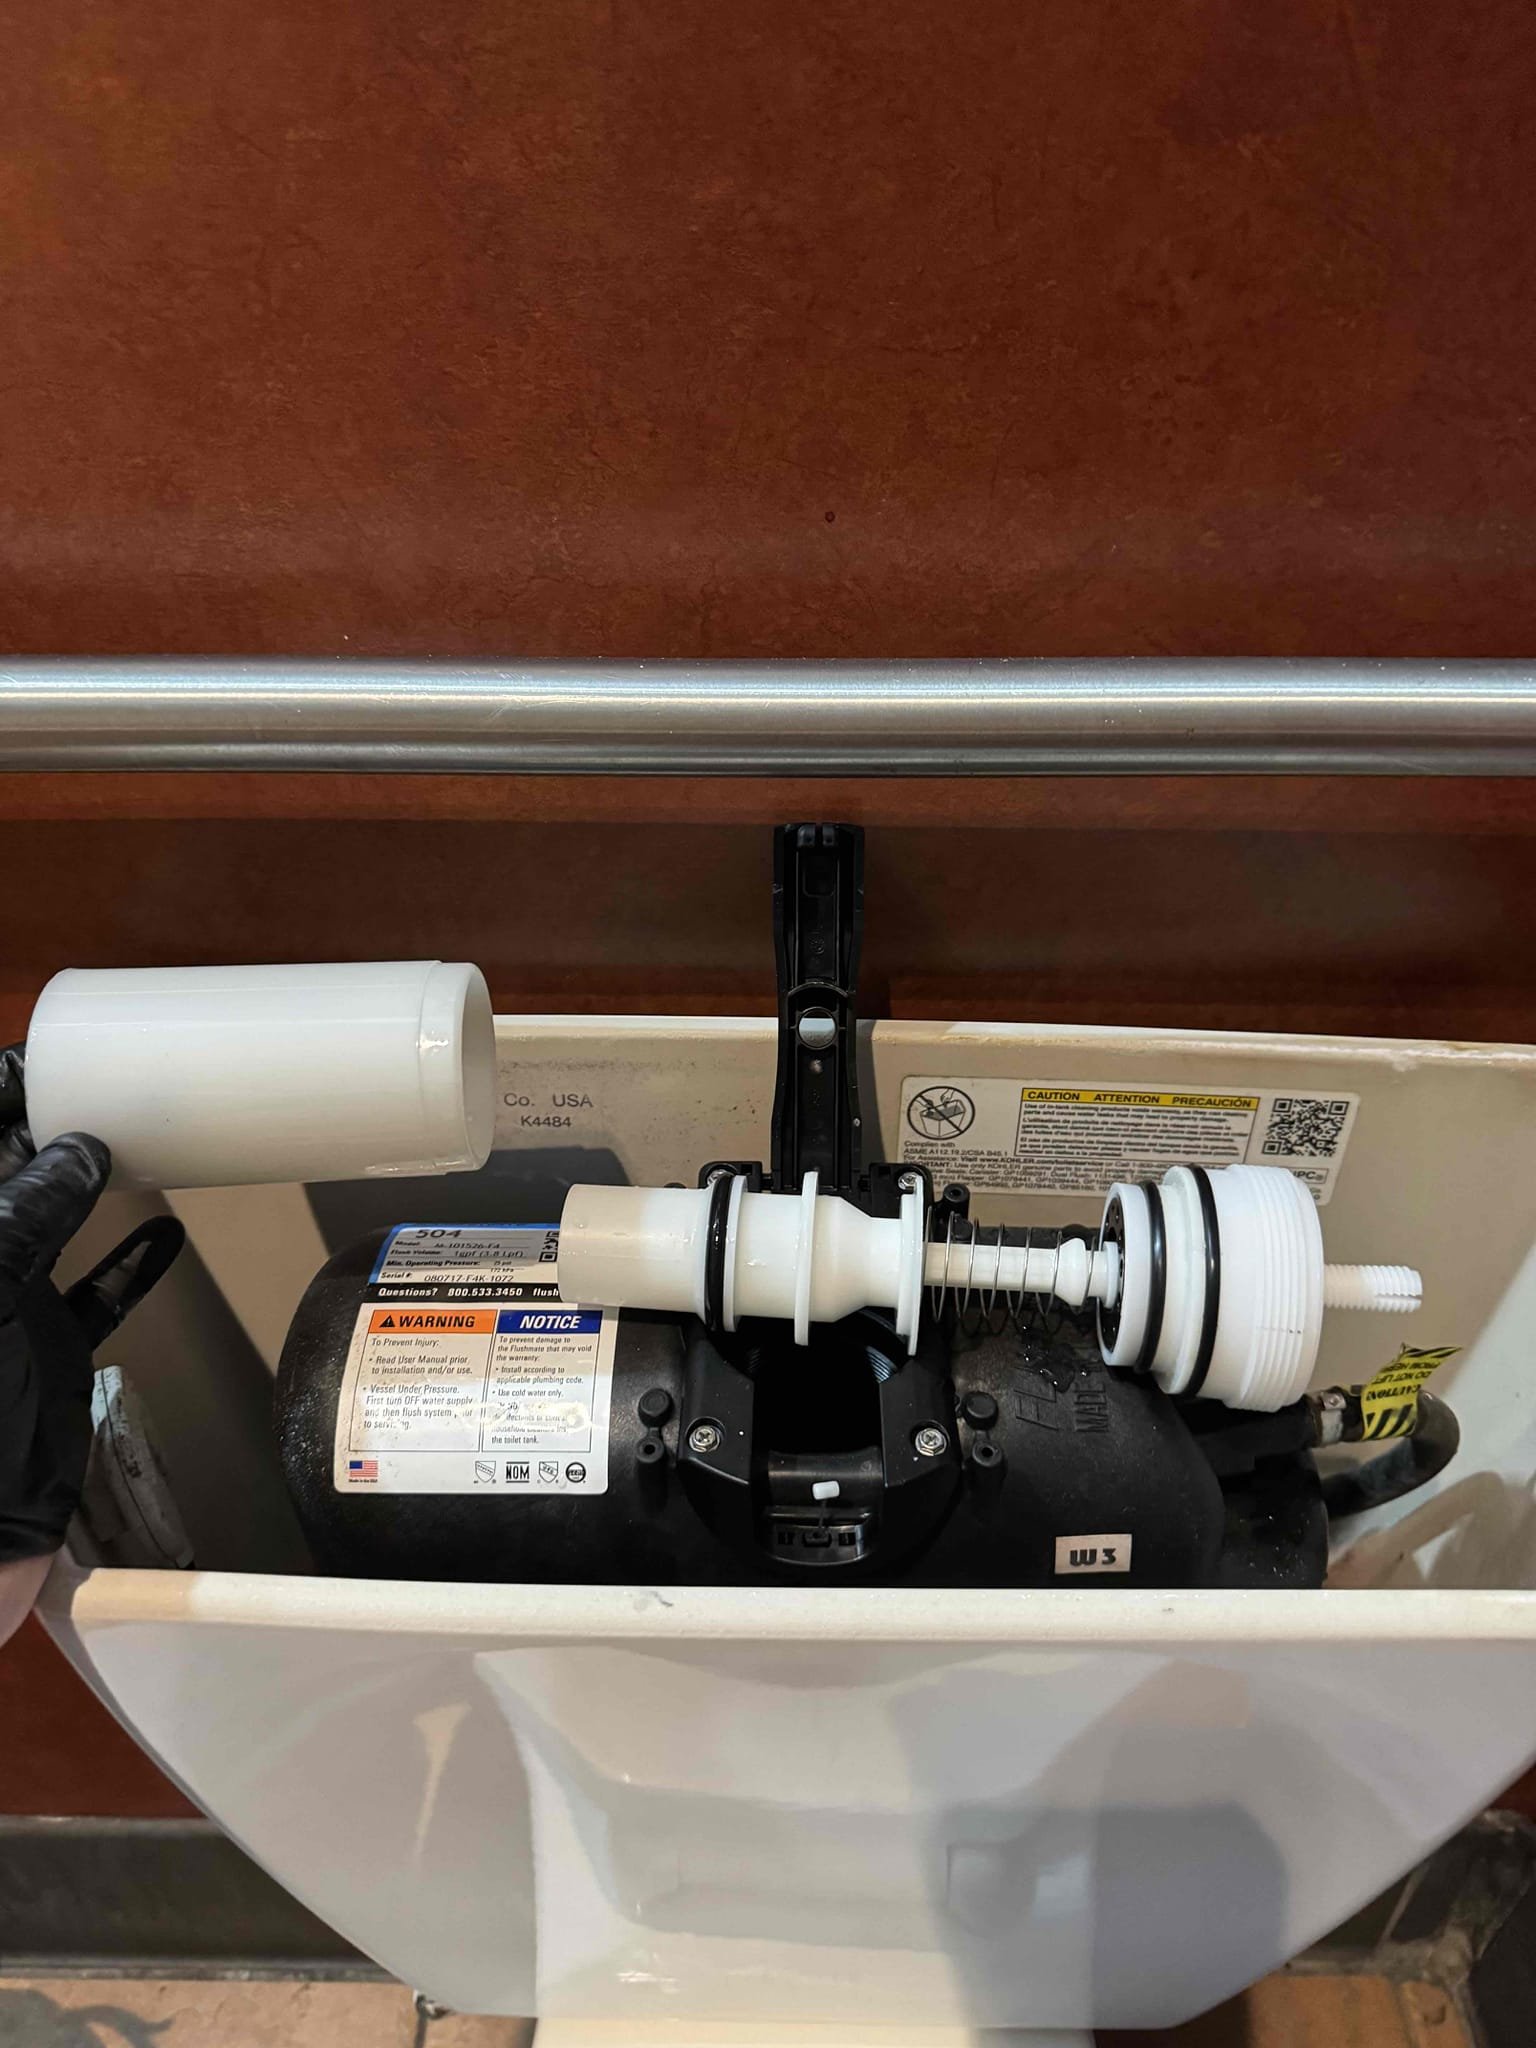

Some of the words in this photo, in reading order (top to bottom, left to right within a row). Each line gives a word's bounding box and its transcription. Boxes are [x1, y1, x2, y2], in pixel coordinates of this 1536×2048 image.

[504, 1092, 536, 1106] Co.
[552, 1094, 594, 1108] USA
[1028, 1090, 1080, 1100] CAUTION
[1094, 1093, 1160, 1104] ATTENTION
[1172, 1096, 1252, 1108] PRECAUCIÓN
[520, 1115, 572, 1127] K4484
[416, 1229, 462, 1238] 504
[378, 1287, 438, 1296] Questions?
[400, 1316, 476, 1328] WARNING
[520, 1316, 582, 1329] NOTICE
[372, 1338, 381, 1346] To
[383, 1338, 412, 1346] Prevent
[415, 1338, 439, 1348] Injury:
[536, 1336, 561, 1344] damage
[449, 1357, 468, 1365] prior
[382, 1366, 425, 1374] installation
[428, 1366, 454, 1375] and/or
[497, 1376, 531, 1384] applicable
[532, 1376, 563, 1384] plumbing
[370, 1385, 395, 1394] Vessel
[398, 1385, 421, 1393] Under
[424, 1385, 459, 1393] Pressure.
[367, 1396, 384, 1405] First
[404, 1396, 419, 1405] OFF
[447, 1397, 473, 1407] supply
[382, 1408, 399, 1416] then
[402, 1408, 421, 1416] flush
[424, 1409, 451, 1418] system
[491, 1435, 502, 1444] the
[504, 1435, 521, 1444] toilet
[523, 1435, 539, 1444] tank.
[506, 1464, 530, 1480] NOM
[1102, 1548, 1117, 1565] 3
